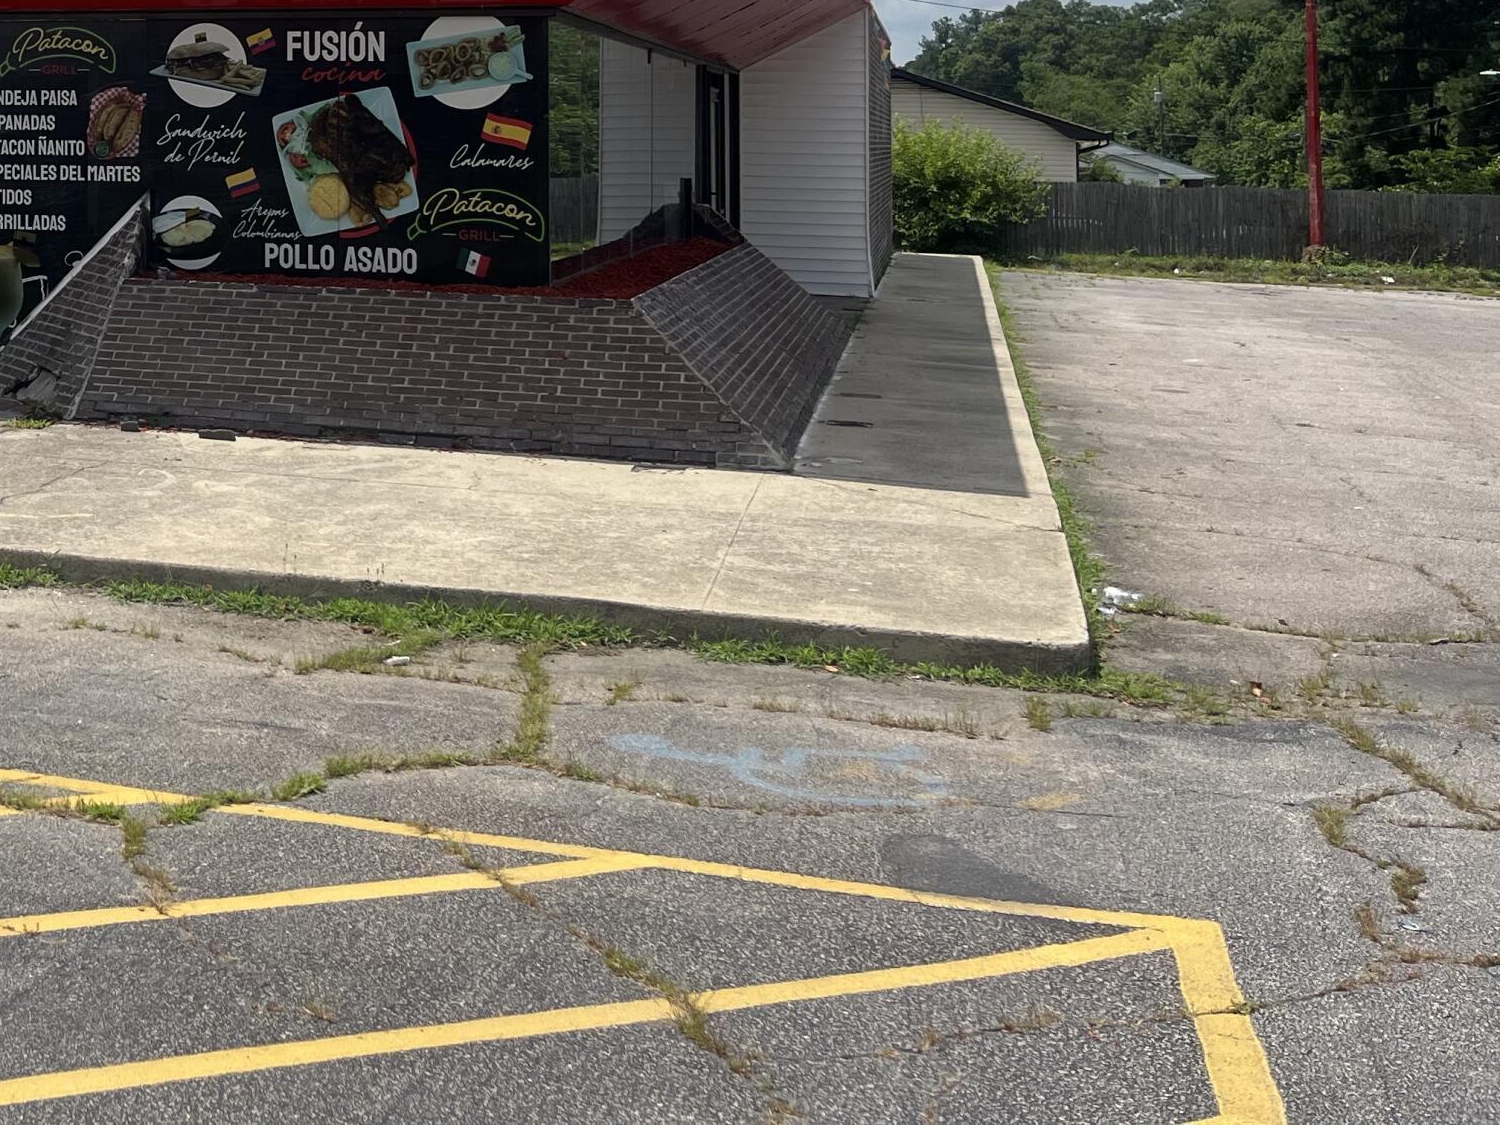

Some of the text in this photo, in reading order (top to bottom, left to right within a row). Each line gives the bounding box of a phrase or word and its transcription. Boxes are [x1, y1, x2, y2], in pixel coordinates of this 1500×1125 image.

[12, 27, 108, 63] Patacon
[286, 21, 385, 62] FUSIÓN
[40, 65, 79, 75] GRILL
[40, 90, 78, 107] PAISA
[156, 111, 248, 145] Sandwich
[37, 135, 86, 157] ÑANITO
[164, 138, 245, 172] de Pernil
[449, 142, 535, 170] Calamares
[59, 165, 85, 182] DEL
[87, 166, 141, 183] MARTES
[240, 197, 290, 226] Arepas
[423, 188, 537, 226] Patacon
[232, 220, 303, 240] Colombianas
[457, 229, 501, 242] GRILL
[264, 242, 418, 275] POLLO ASADO
